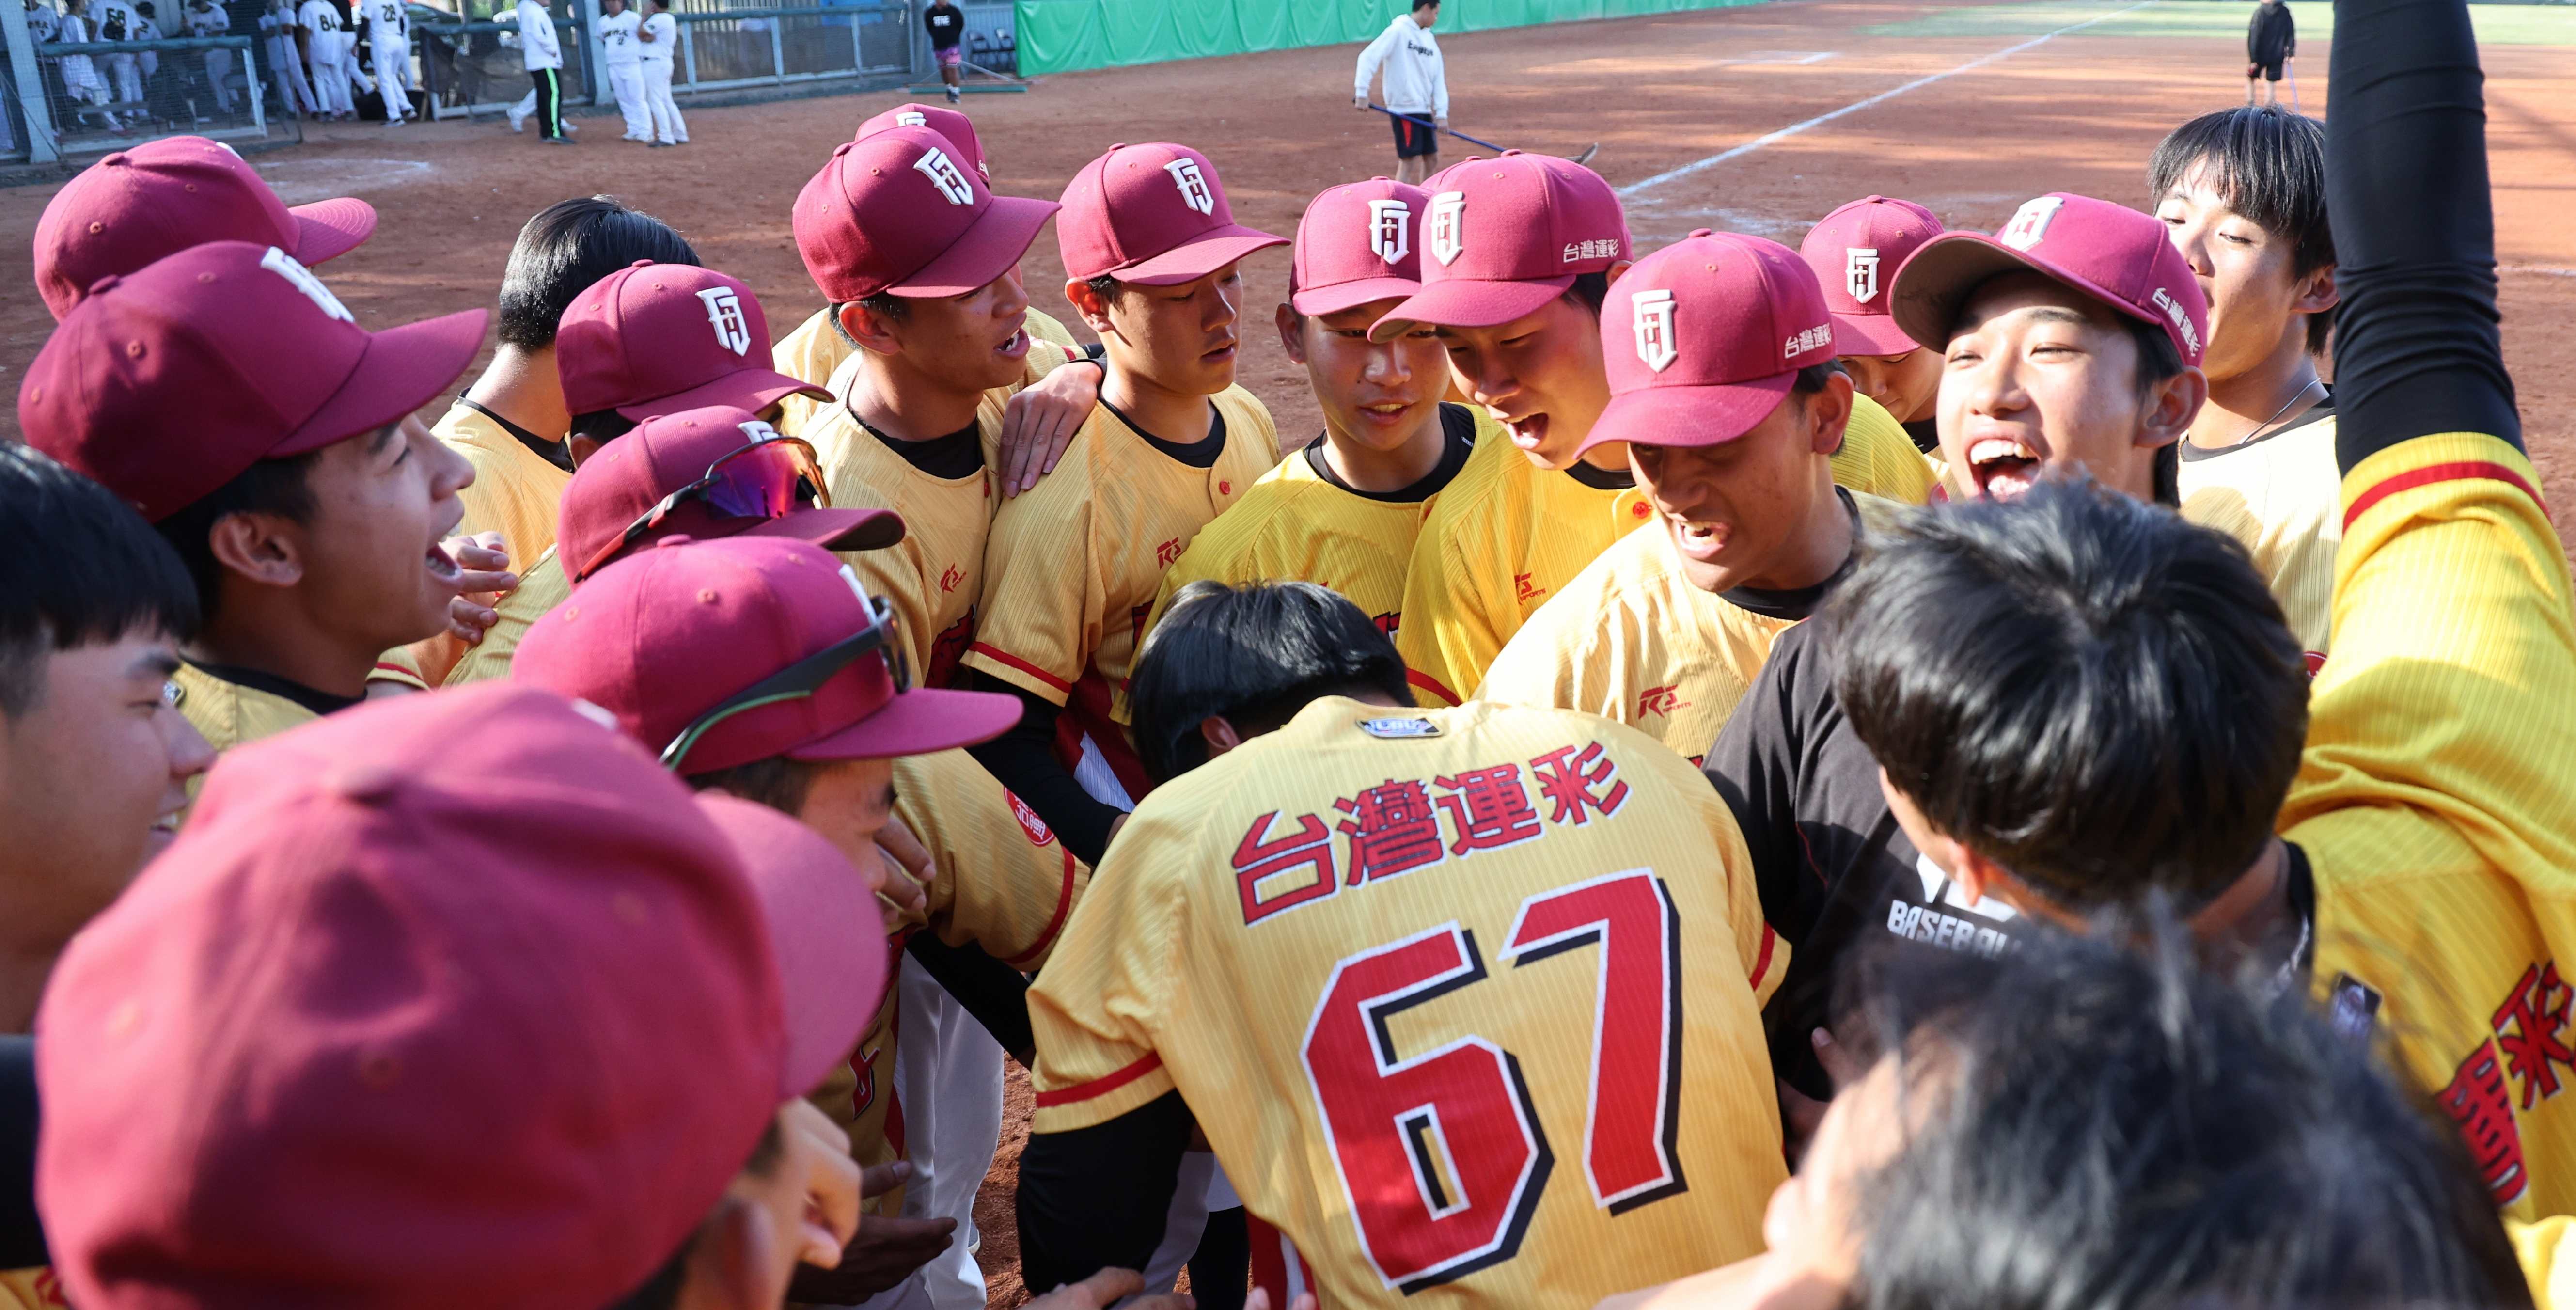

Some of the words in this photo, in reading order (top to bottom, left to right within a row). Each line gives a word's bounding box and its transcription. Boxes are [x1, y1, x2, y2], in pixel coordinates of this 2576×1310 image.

[1563, 238, 1619, 263] 台灣運彩
[1785, 322, 1832, 359] 台灣運彩
[1231, 740, 1633, 928] 台灣運彩
[1299, 866, 1689, 1298] 67
